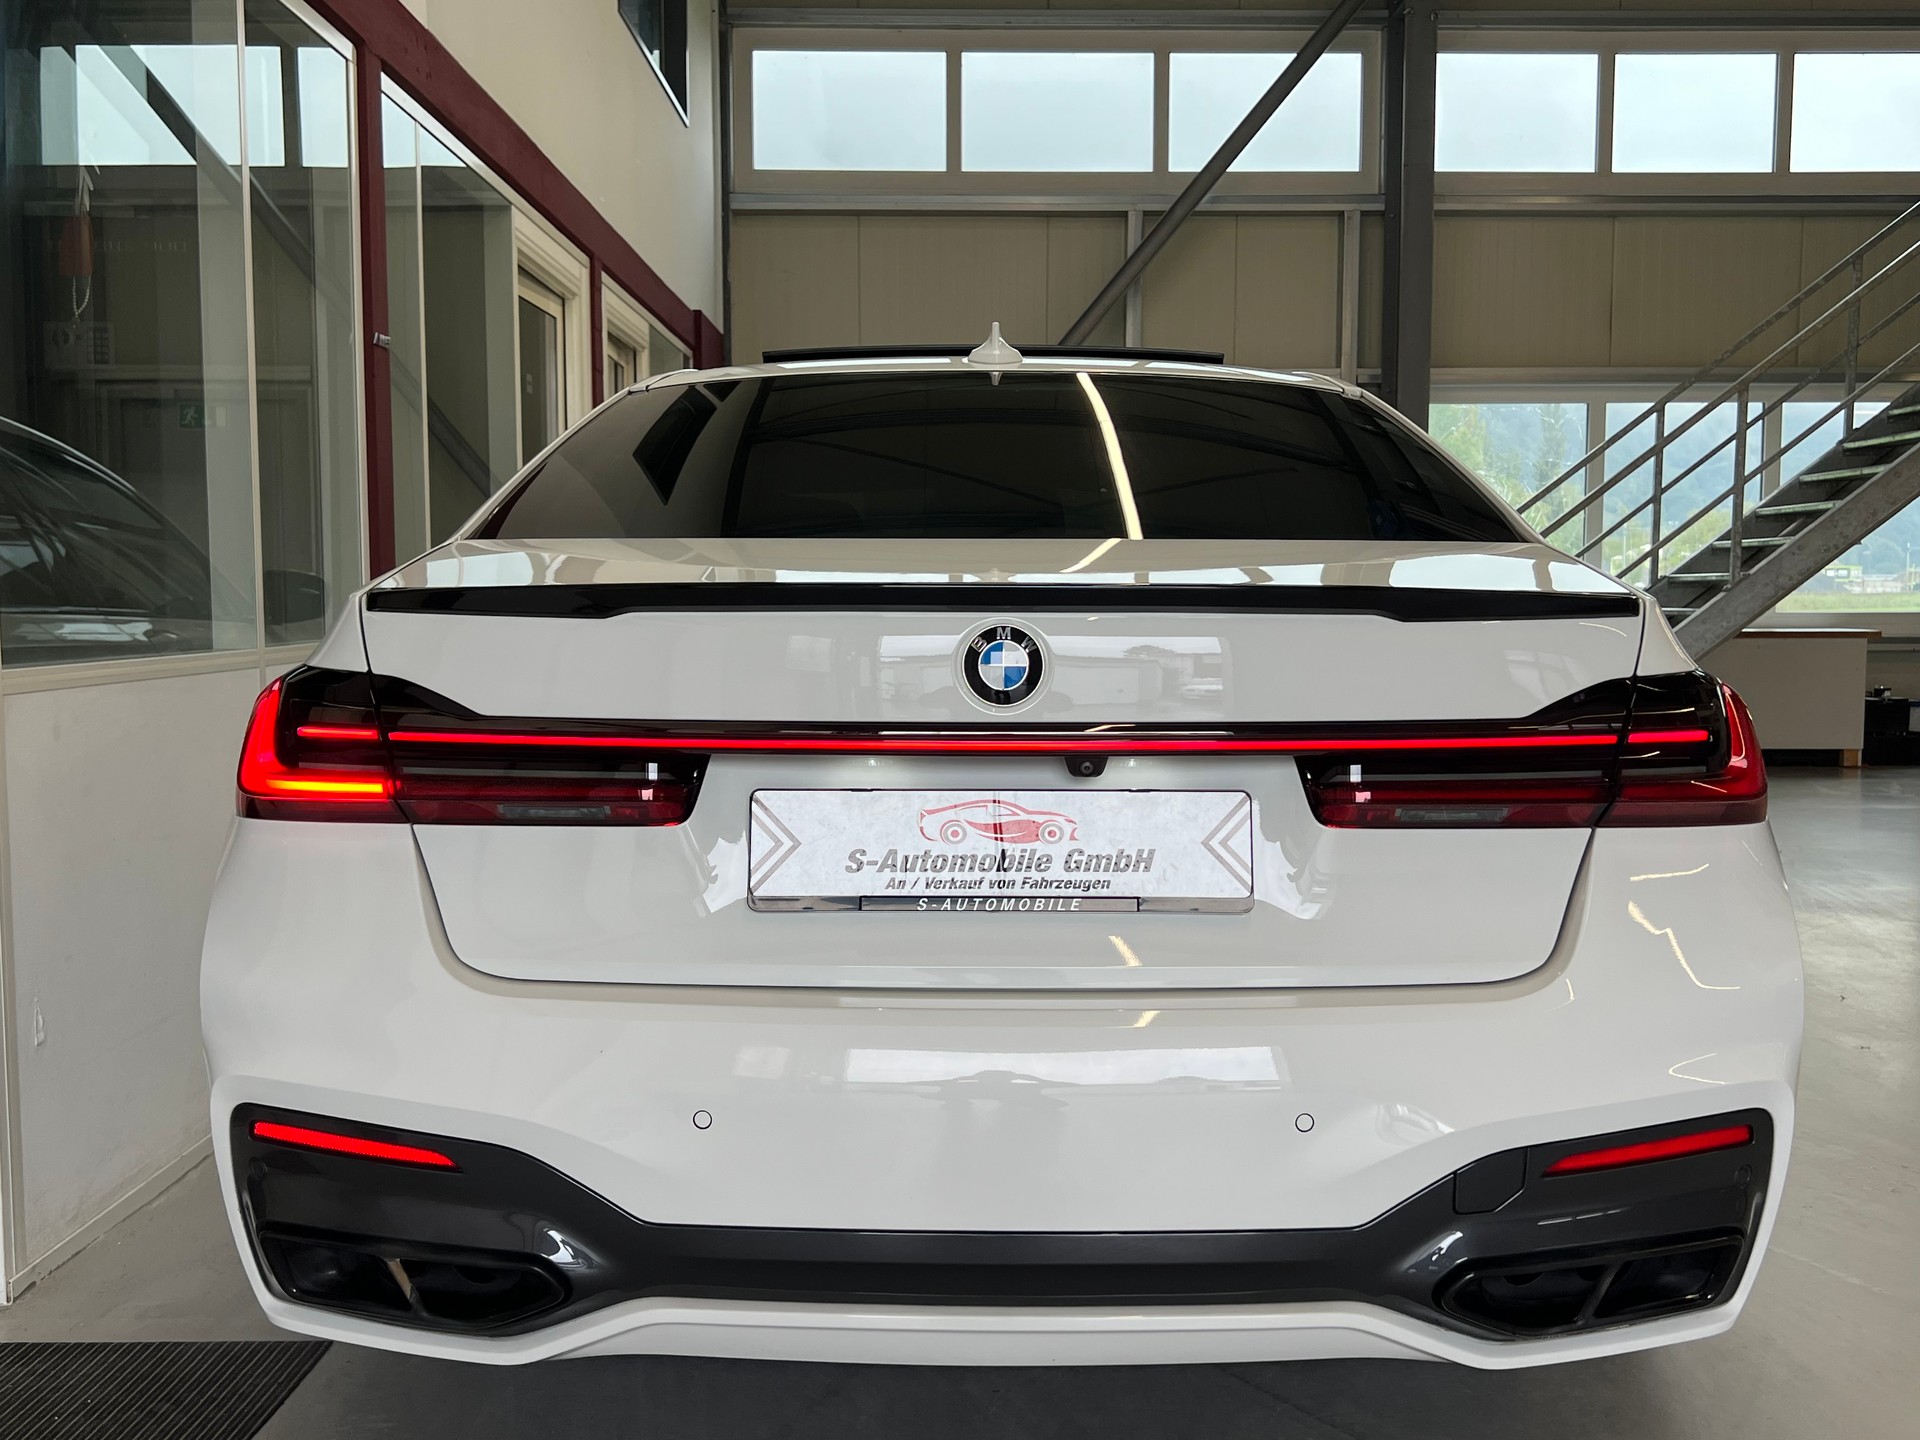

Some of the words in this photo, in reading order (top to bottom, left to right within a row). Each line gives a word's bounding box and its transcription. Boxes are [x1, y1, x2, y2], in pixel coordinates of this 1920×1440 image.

[970, 626, 1037, 653] BMW
[845, 848, 1053, 874] S-Automobile
[1063, 848, 1156, 873] GmbH
[885, 877, 907, 890] An
[911, 877, 920, 890] /
[925, 877, 985, 890] Verkauf
[988, 880, 1016, 890] von
[1021, 877, 1111, 892] Fahrzeugen
[917, 898, 1082, 911] S-AUTOMOBILE
